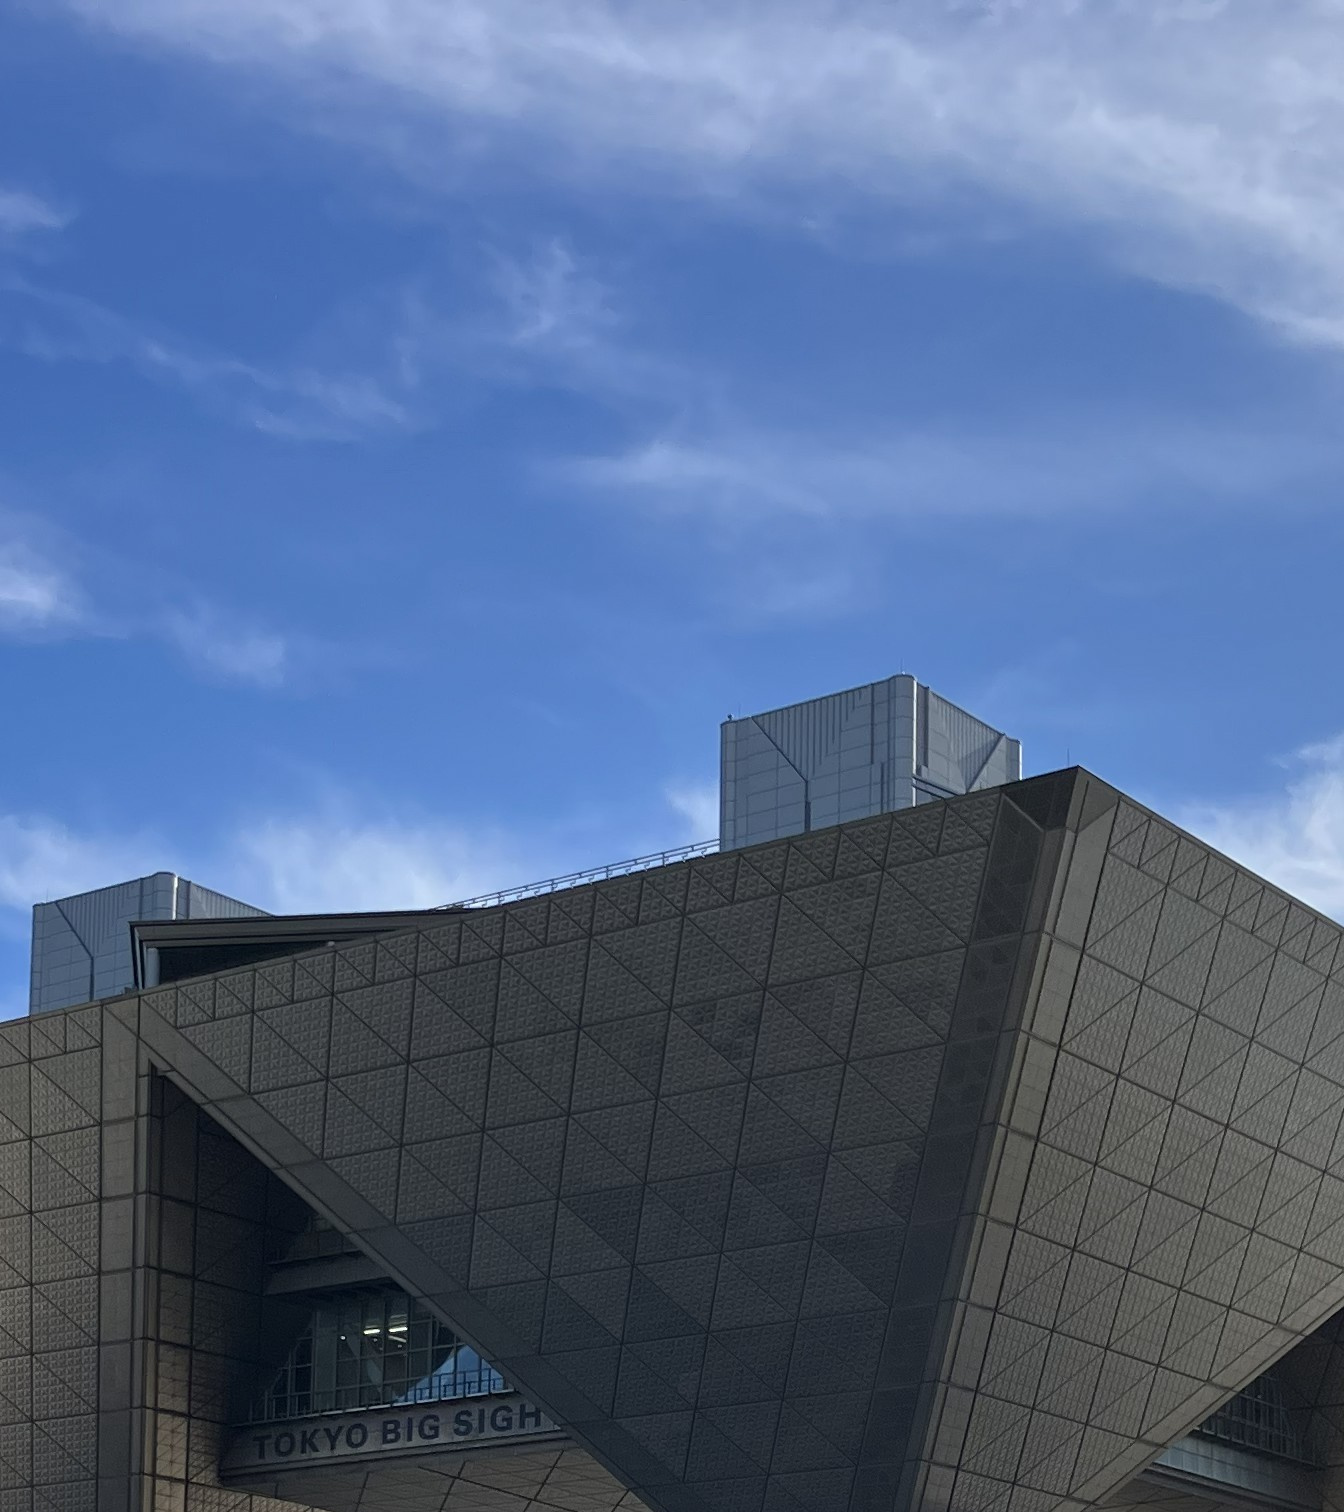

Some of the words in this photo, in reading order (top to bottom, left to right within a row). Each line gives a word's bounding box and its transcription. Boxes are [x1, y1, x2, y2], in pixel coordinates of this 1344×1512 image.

[254, 1423, 368, 1460] TOKYO
[382, 1414, 440, 1445] BIG
[453, 1403, 542, 1436] SIGH
